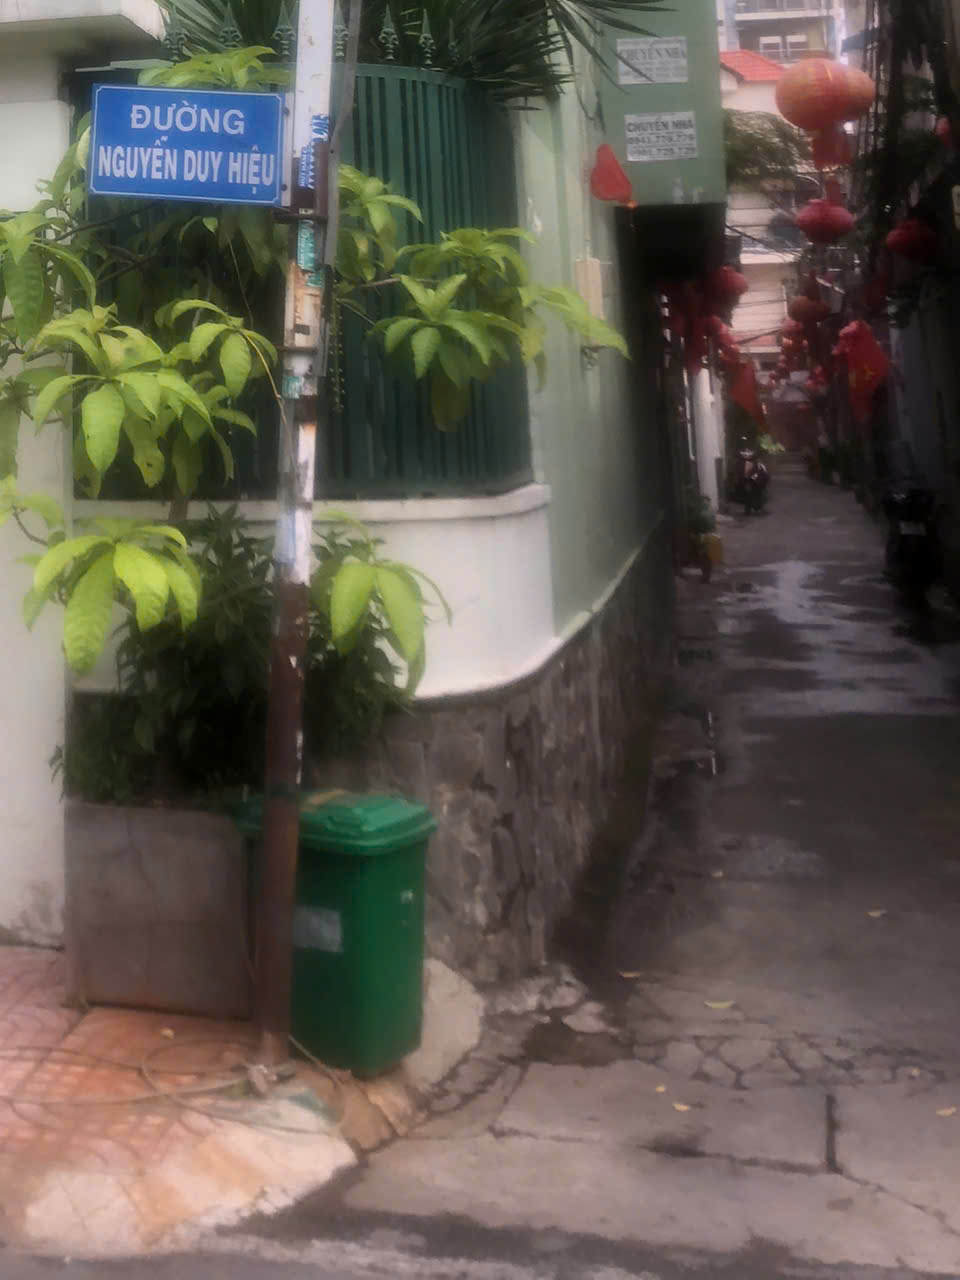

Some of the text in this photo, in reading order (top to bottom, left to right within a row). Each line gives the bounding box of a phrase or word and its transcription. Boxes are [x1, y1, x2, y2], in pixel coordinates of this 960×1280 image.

[130, 100, 245, 135] ĐƯỜNG
[98, 136, 177, 180] NGUYỄN
[183, 149, 223, 182] DUY
[228, 144, 275, 195] HIỆU
